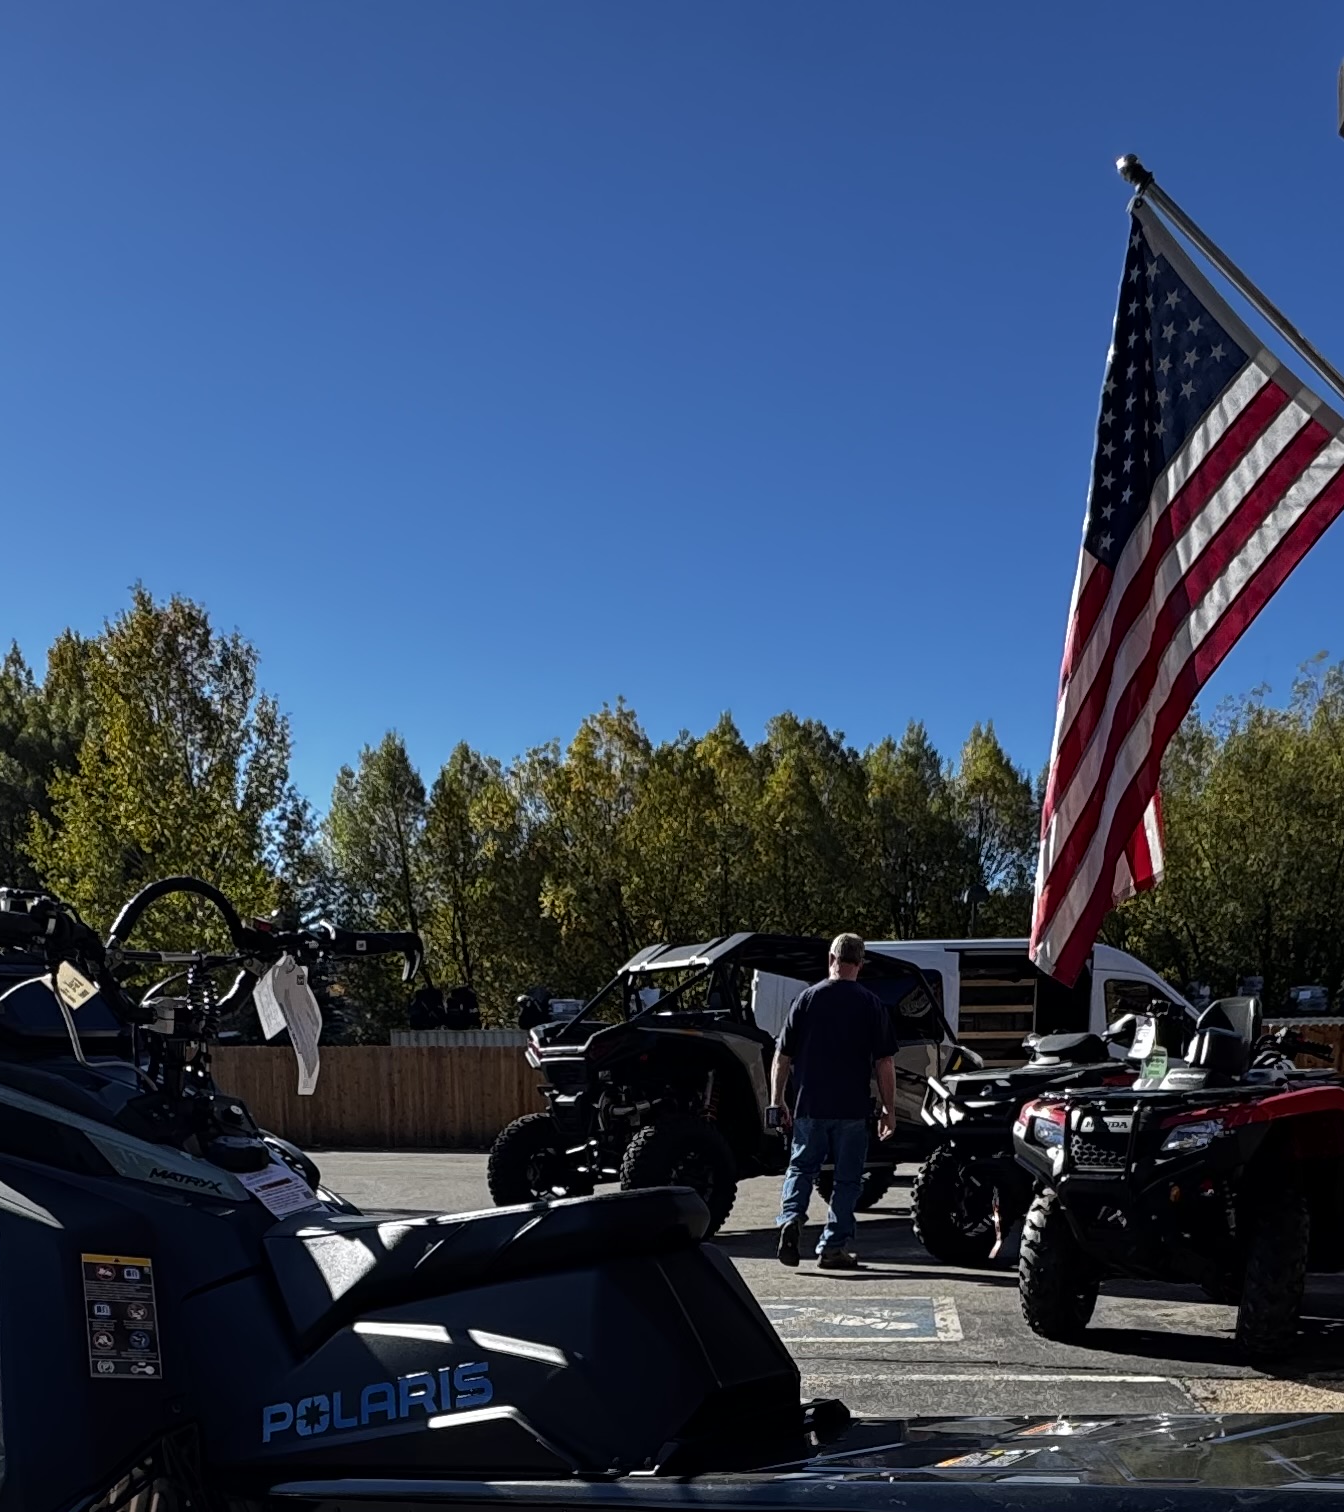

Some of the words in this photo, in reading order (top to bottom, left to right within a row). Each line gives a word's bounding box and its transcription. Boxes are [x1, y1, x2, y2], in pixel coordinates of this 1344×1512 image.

[1085, 1120, 1129, 1129] HDA
[149, 1167, 223, 1195] MATRYX
[261, 1361, 495, 1444] POLARIS
